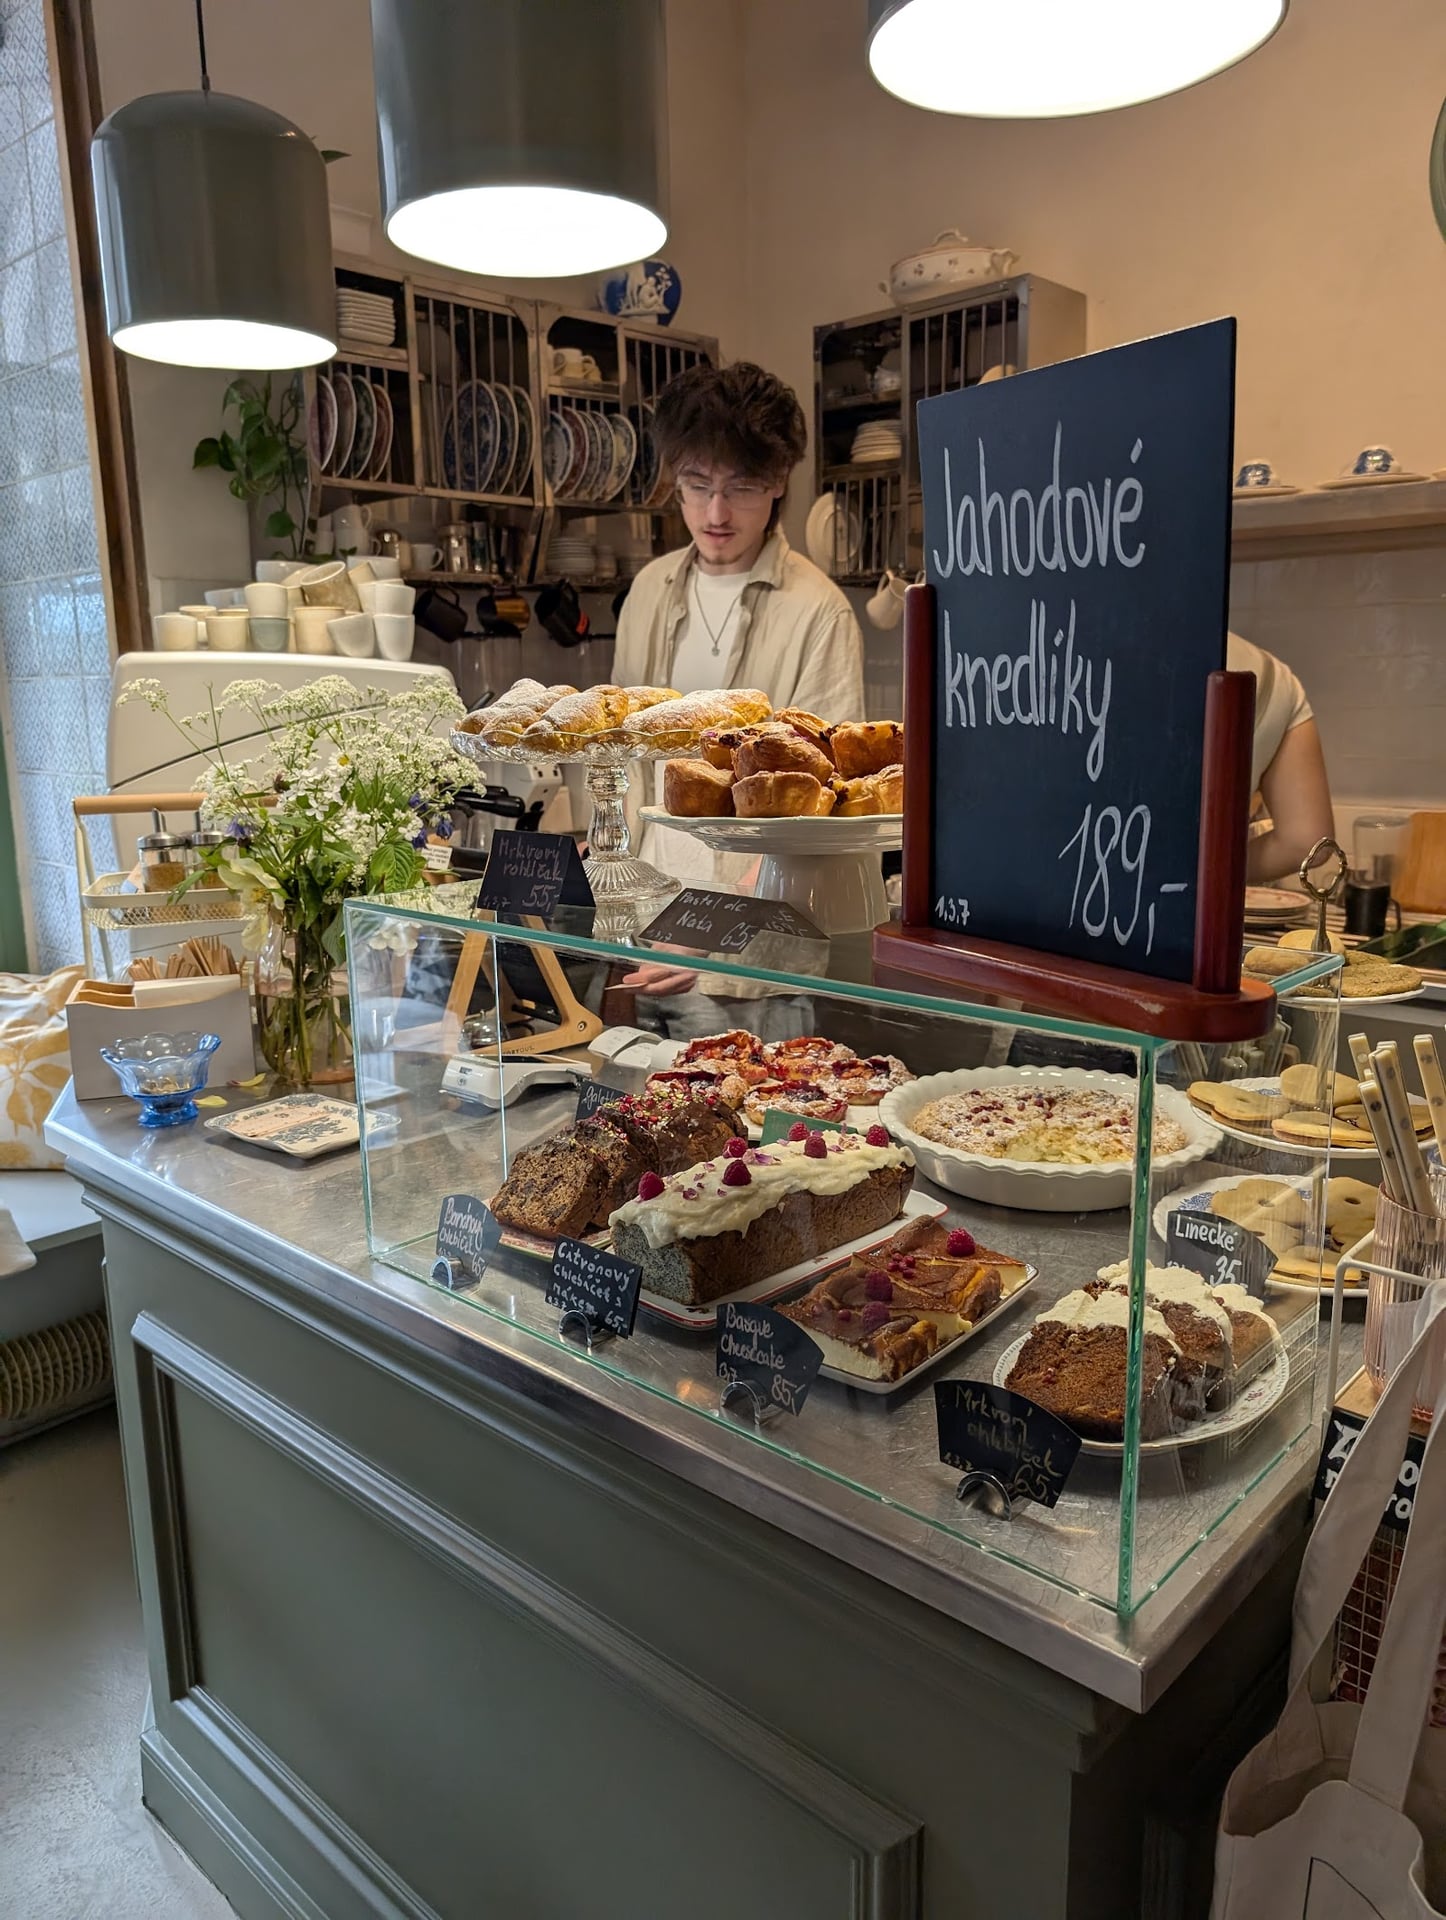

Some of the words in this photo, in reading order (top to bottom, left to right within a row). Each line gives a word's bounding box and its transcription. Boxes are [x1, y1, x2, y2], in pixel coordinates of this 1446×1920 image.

[933, 420, 1146, 578] Jahodové
[1058, 803, 1188, 957] 189,-
[676, 910, 712, 934] Nata
[1175, 1214, 1239, 1252] Linecké
[558, 1241, 635, 1292] Citrónový
[726, 1302, 774, 1349] Basque
